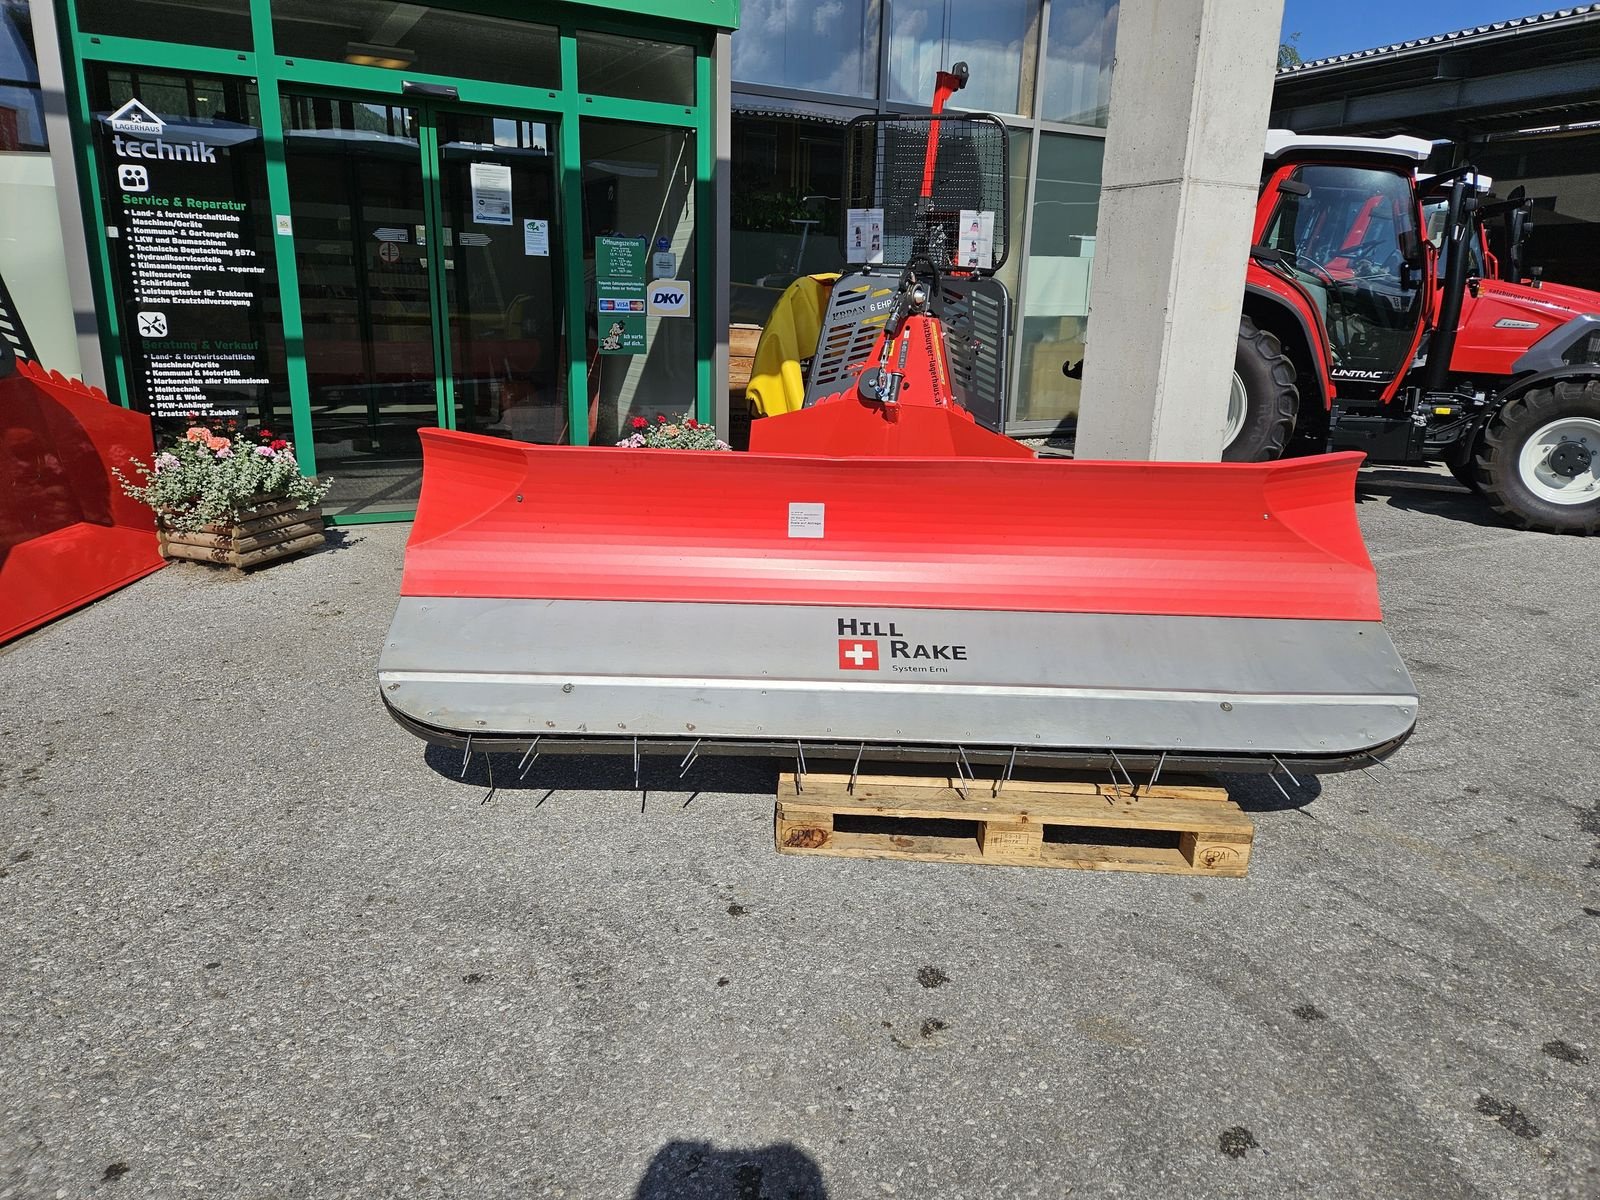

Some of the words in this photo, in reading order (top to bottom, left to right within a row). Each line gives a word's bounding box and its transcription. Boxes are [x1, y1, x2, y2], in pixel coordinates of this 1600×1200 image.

[115, 123, 160, 132] LAGERHAUS
[112, 135, 216, 163] technik
[122, 195, 169, 206] Service
[174, 198, 182, 207] &
[187, 198, 246, 210] Reparatur
[165, 211, 240, 222] forstwirtschaftliche
[132, 218, 202, 228] Maschinen/Geräte
[134, 227, 178, 235] Kommunal-
[189, 230, 238, 238] Gartengeräte
[172, 238, 226, 246] Baumaschinen
[602, 238, 639, 247] Öffnungszeiten
[181, 247, 233, 256] Begutachtung
[137, 253, 221, 263] Hydraulikservicestelle
[138, 262, 216, 271] Klimaanlagenservice
[227, 266, 265, 274] -reparatur
[140, 279, 189, 287] Schärfdienst
[142, 288, 201, 297] Leistungstester
[172, 297, 250, 307] Ersatzteilversorgung
[653, 294, 684, 303] DKV
[870, 303, 875, 311] 6
[877, 300, 891, 310] EHP
[142, 340, 197, 350] Beratung
[202, 341, 209, 349] &
[215, 341, 258, 350] Verkauf
[923, 319, 942, 406] salzburger-lagerhaus.at
[1331, 368, 1383, 379] LINTRAC
[838, 618, 903, 637] HILL
[891, 640, 967, 660] RAKE
[892, 665, 927, 673] System
